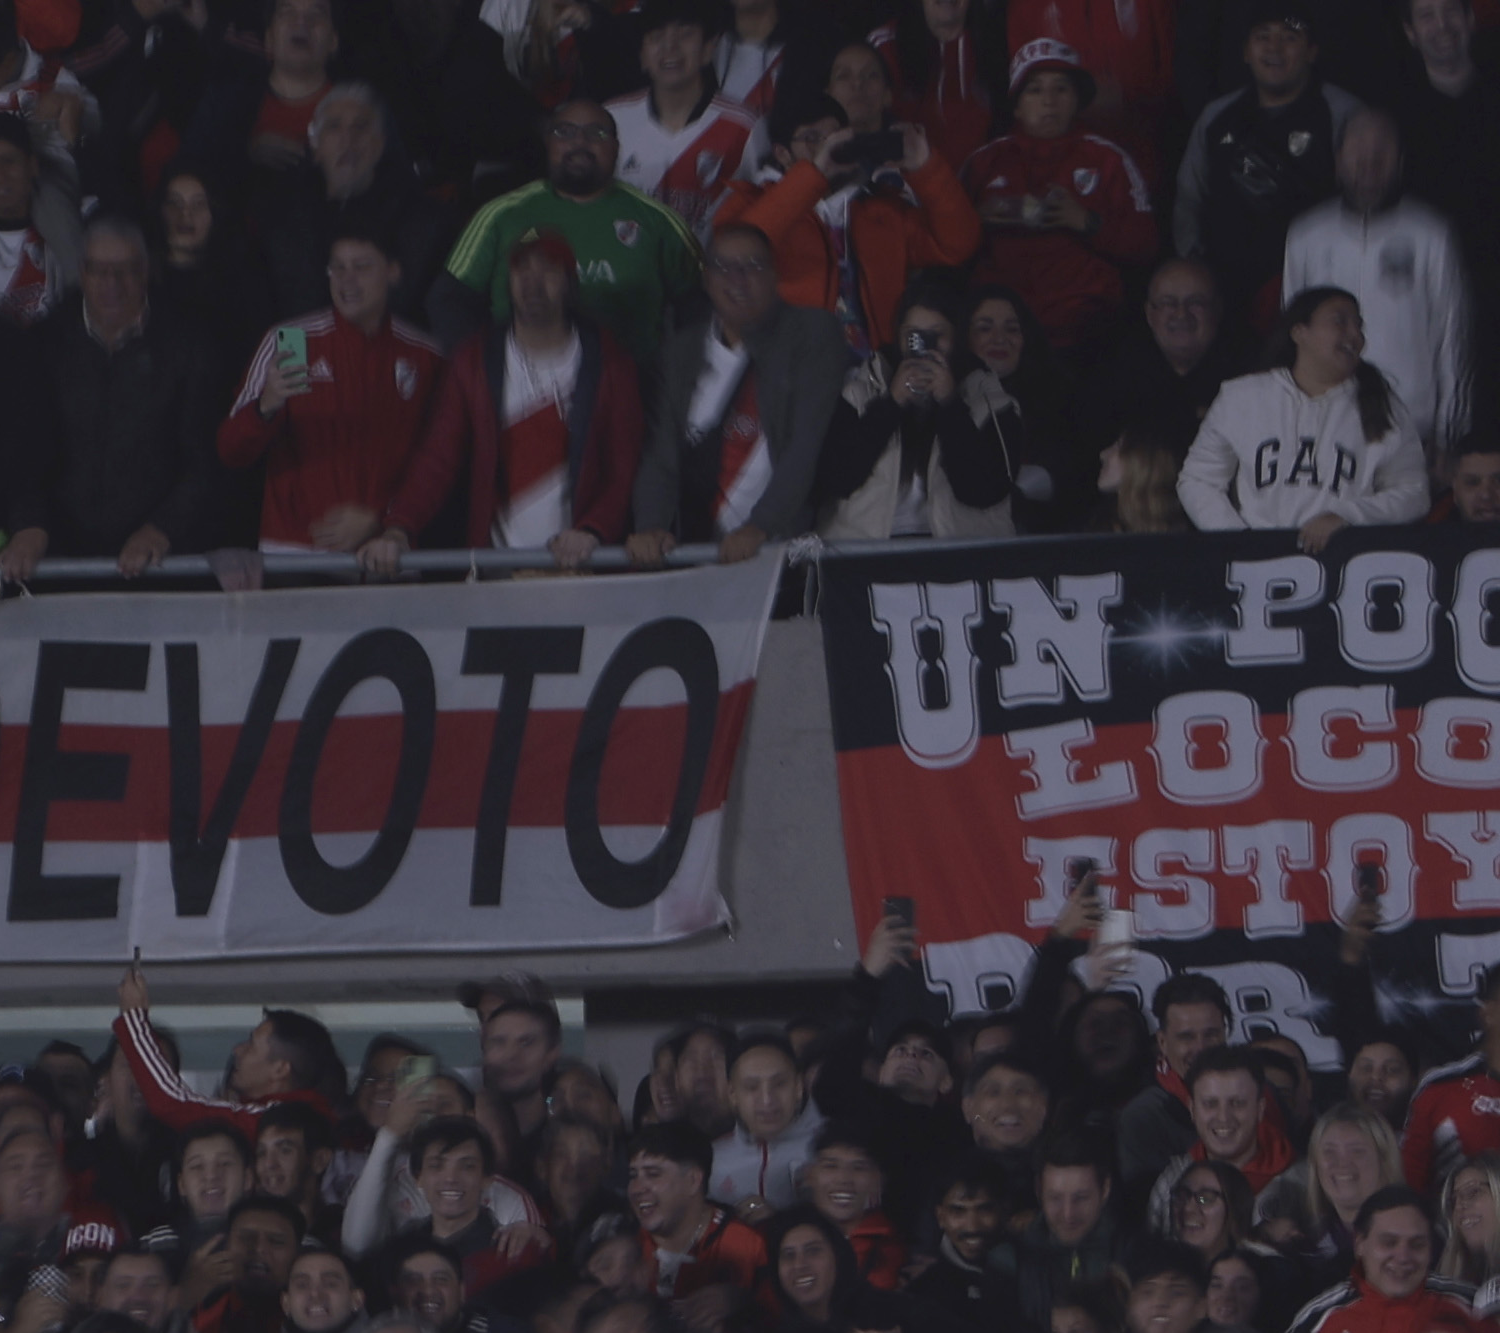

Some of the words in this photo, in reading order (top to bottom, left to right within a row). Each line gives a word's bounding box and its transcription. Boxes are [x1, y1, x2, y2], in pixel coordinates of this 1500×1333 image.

[1254, 435, 1357, 497] GAP
[869, 571, 1124, 770] UN
[1003, 684, 1500, 821] LOCO
[1023, 810, 1500, 940] ESTOY
